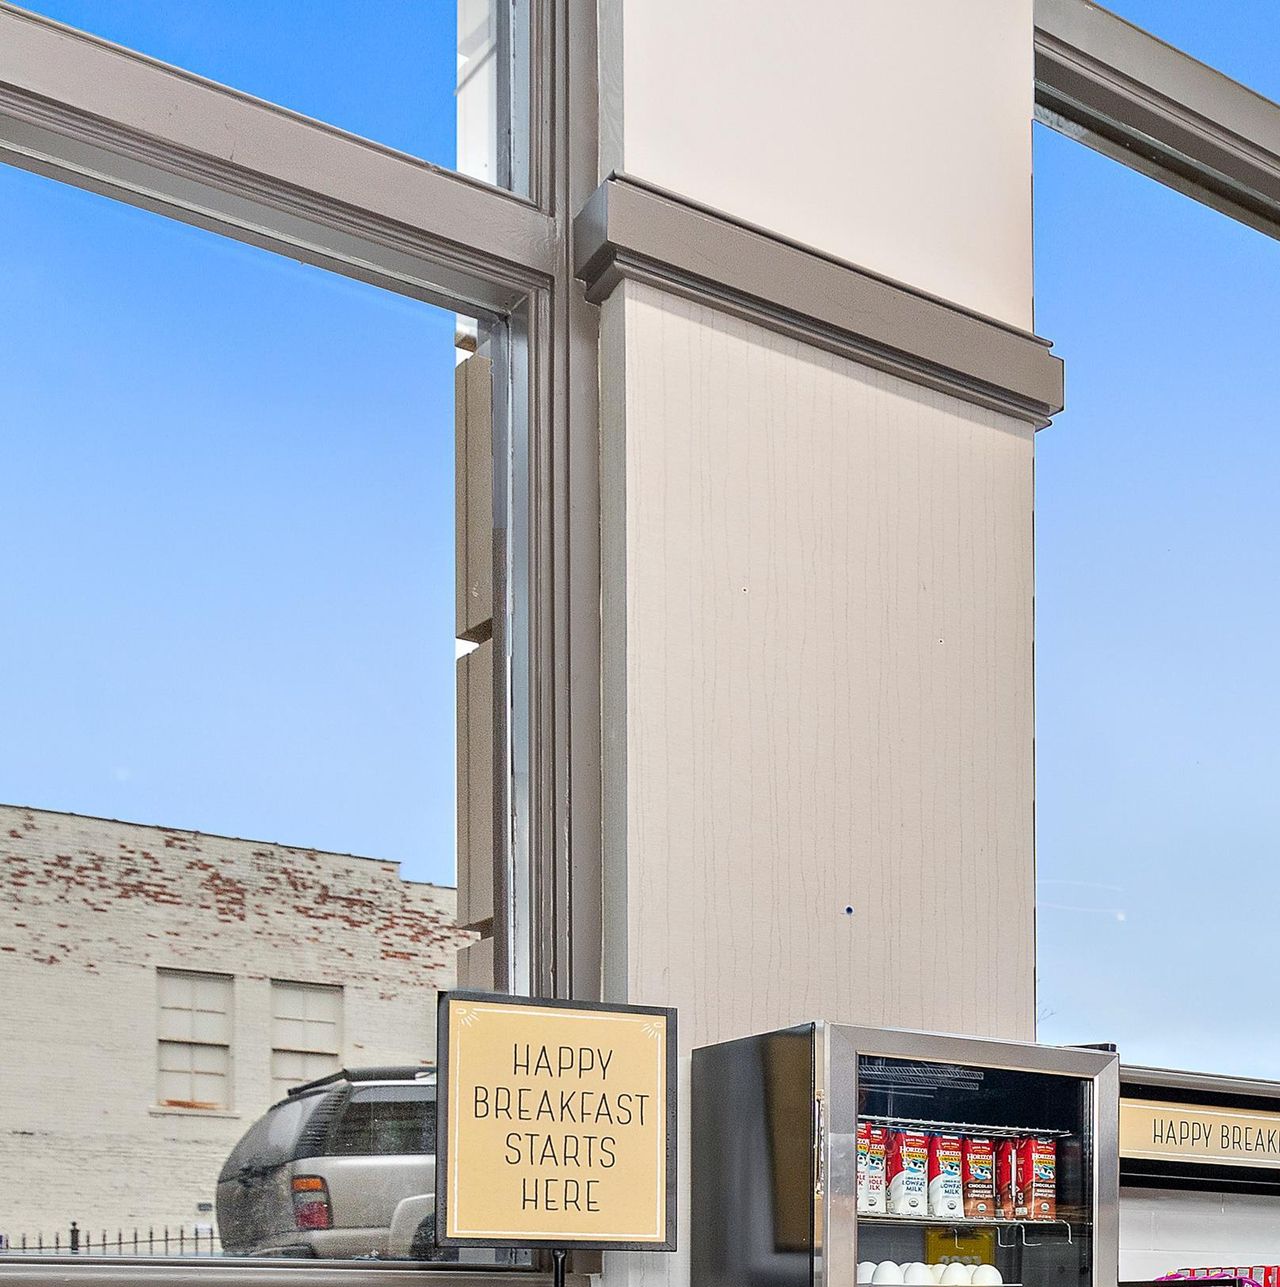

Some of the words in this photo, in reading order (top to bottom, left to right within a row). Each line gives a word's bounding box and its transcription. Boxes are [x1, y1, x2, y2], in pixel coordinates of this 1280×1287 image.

[513, 1043, 613, 1080] HAPPY
[474, 1086, 649, 1126] BREAKFAST
[505, 1132, 616, 1168] STARTS
[1153, 1119, 1212, 1148] HAPPY
[522, 1178, 600, 1212] HERE
